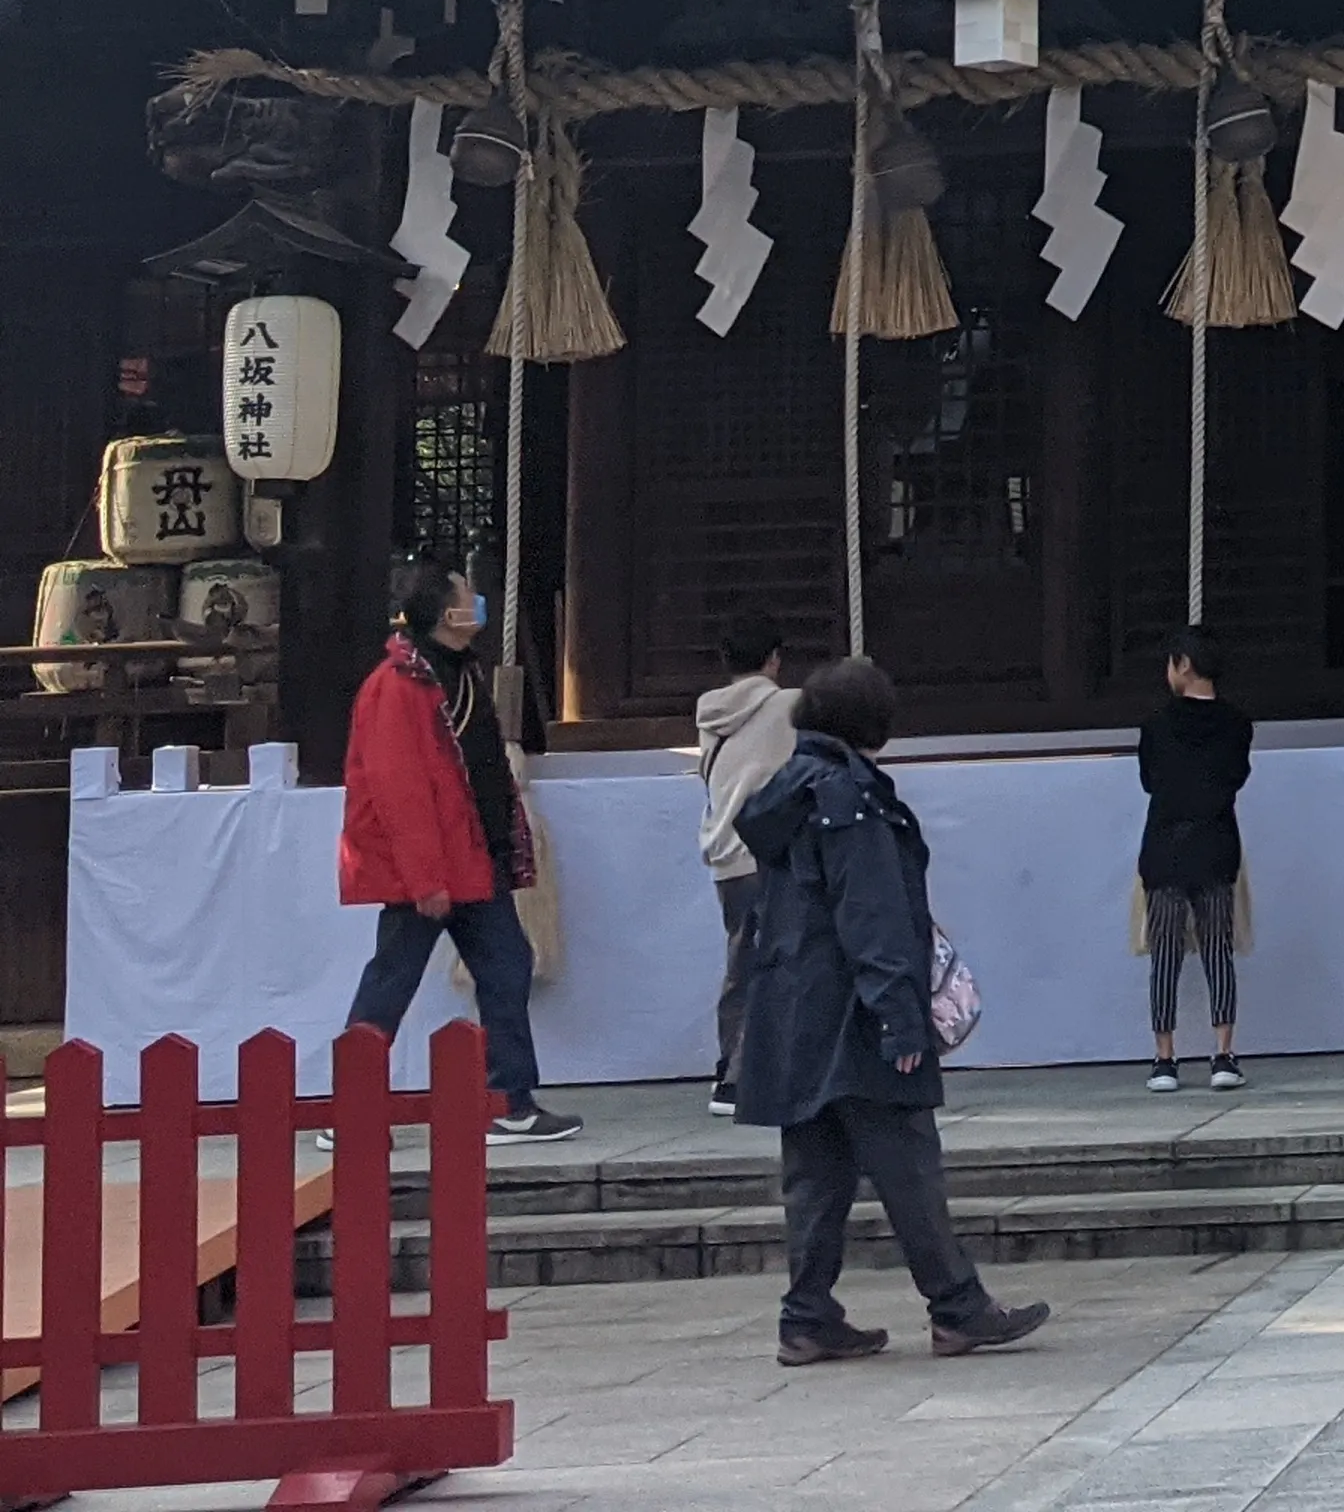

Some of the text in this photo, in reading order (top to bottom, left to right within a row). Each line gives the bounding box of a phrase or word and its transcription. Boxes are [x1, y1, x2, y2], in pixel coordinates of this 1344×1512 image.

[239, 322, 278, 461] 八坂神社
[152, 464, 213, 540] 丹山
